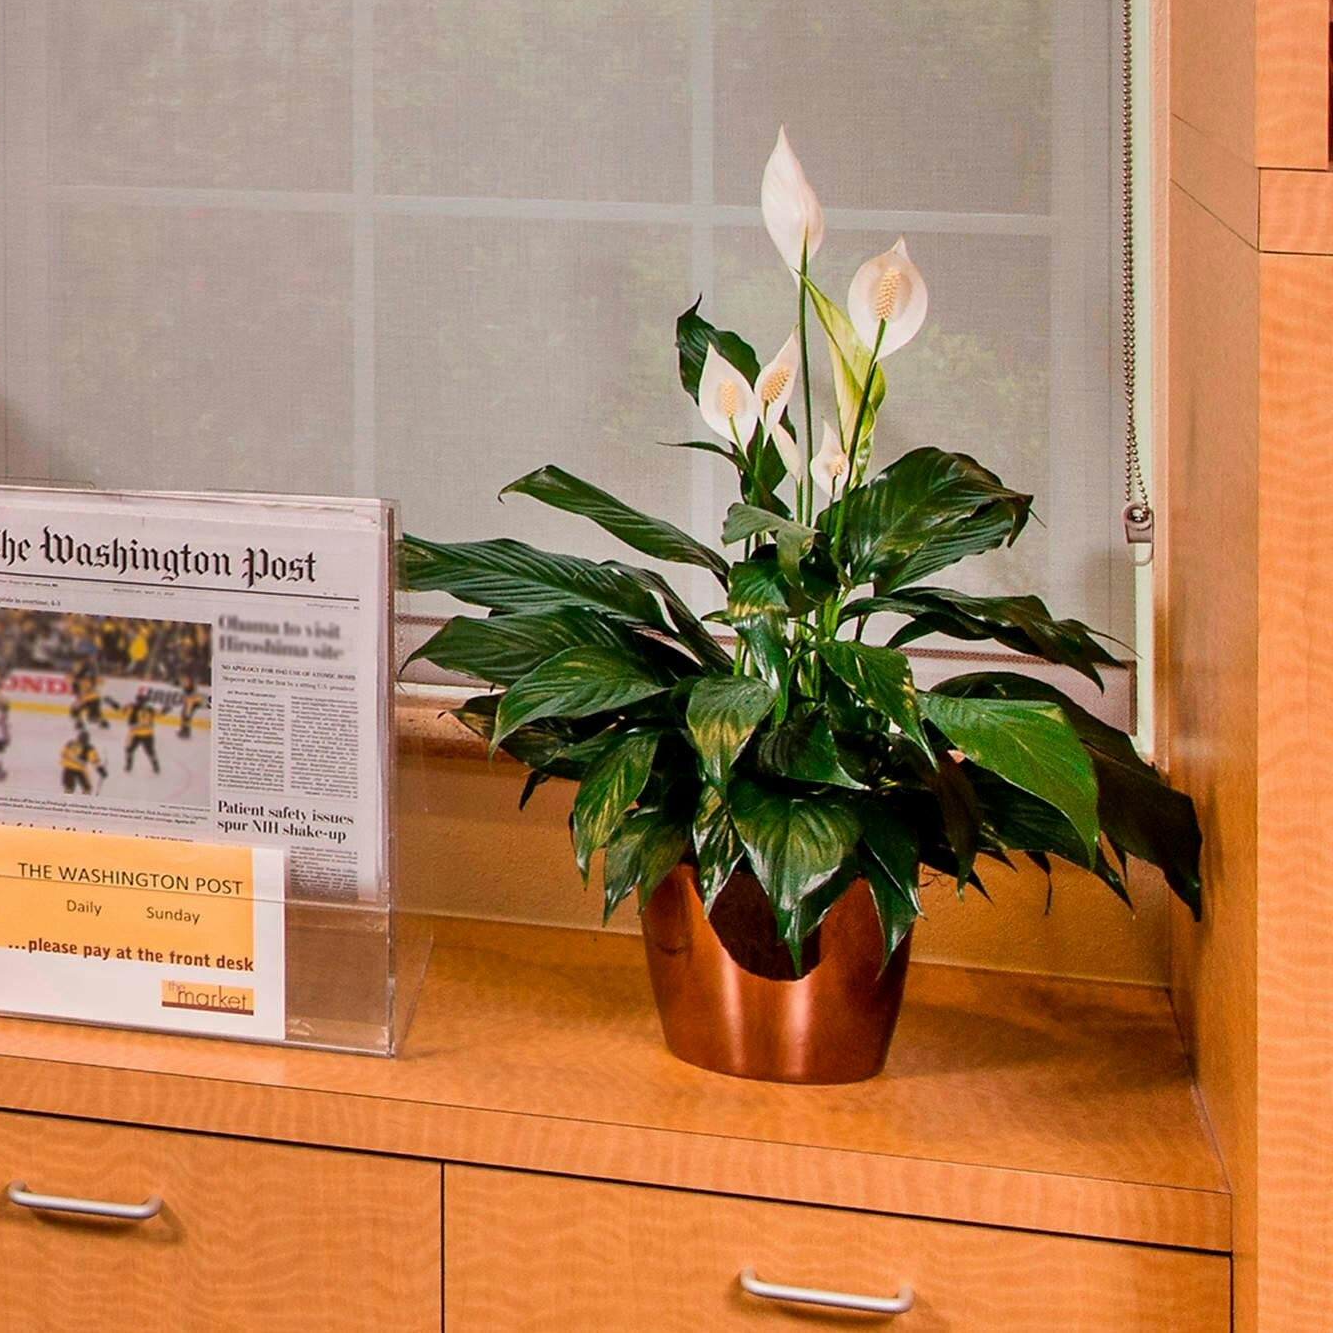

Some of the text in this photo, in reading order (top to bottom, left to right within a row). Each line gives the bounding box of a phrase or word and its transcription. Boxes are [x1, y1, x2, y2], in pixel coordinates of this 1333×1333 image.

[39, 525, 231, 581] Washington
[241, 546, 317, 588] Post
[218, 799, 265, 817] Patient
[269, 806, 308, 824] safety
[312, 809, 354, 825] issues
[217, 820, 249, 834] spur
[252, 819, 279, 835] NIH
[283, 824, 347, 844] shake-up
[17, 862, 243, 895] THE WASHINGTON POST
[66, 899, 201, 925] Daily Sunday
[83, 946, 111, 961] pay
[116, 945, 132, 960] at
[138, 948, 163, 963] the
[169, 950, 211, 968] front
[216, 954, 254, 972] desk
[178, 985, 247, 1011] market
